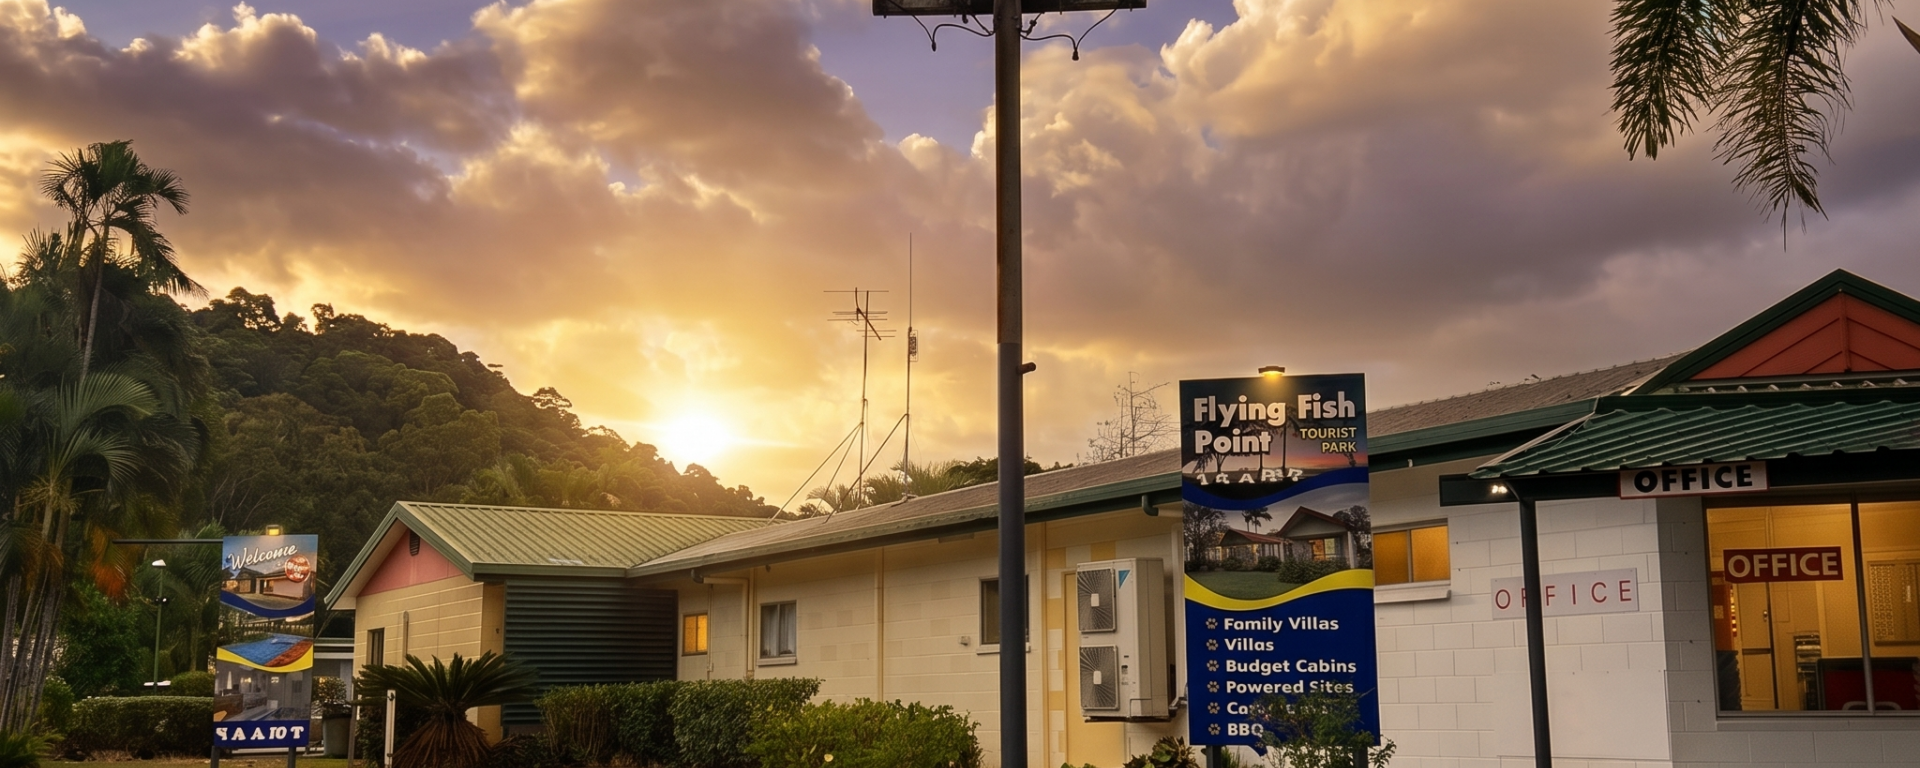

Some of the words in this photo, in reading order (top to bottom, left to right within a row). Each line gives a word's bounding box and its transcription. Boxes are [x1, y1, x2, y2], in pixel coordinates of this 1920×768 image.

[1194, 395, 1286, 427] Flying
[1298, 391, 1356, 419] Fish
[1194, 428, 1271, 454] Point
[1300, 427, 1357, 439] TOURIST
[1321, 442, 1357, 453] PARK
[1634, 465, 1753, 493] OFFICE
[228, 545, 298, 570] Welcome
[1728, 552, 1839, 578] OFFICE
[1223, 617, 1283, 633] Family
[1288, 616, 1339, 630] Villas
[1224, 638, 1275, 651] Villas
[1226, 659, 1290, 676] Budget
[1296, 659, 1357, 673] Cabins
[1226, 680, 1304, 693] Powered
[1309, 680, 1354, 693] Sites
[1227, 722, 1264, 738] BBQ
